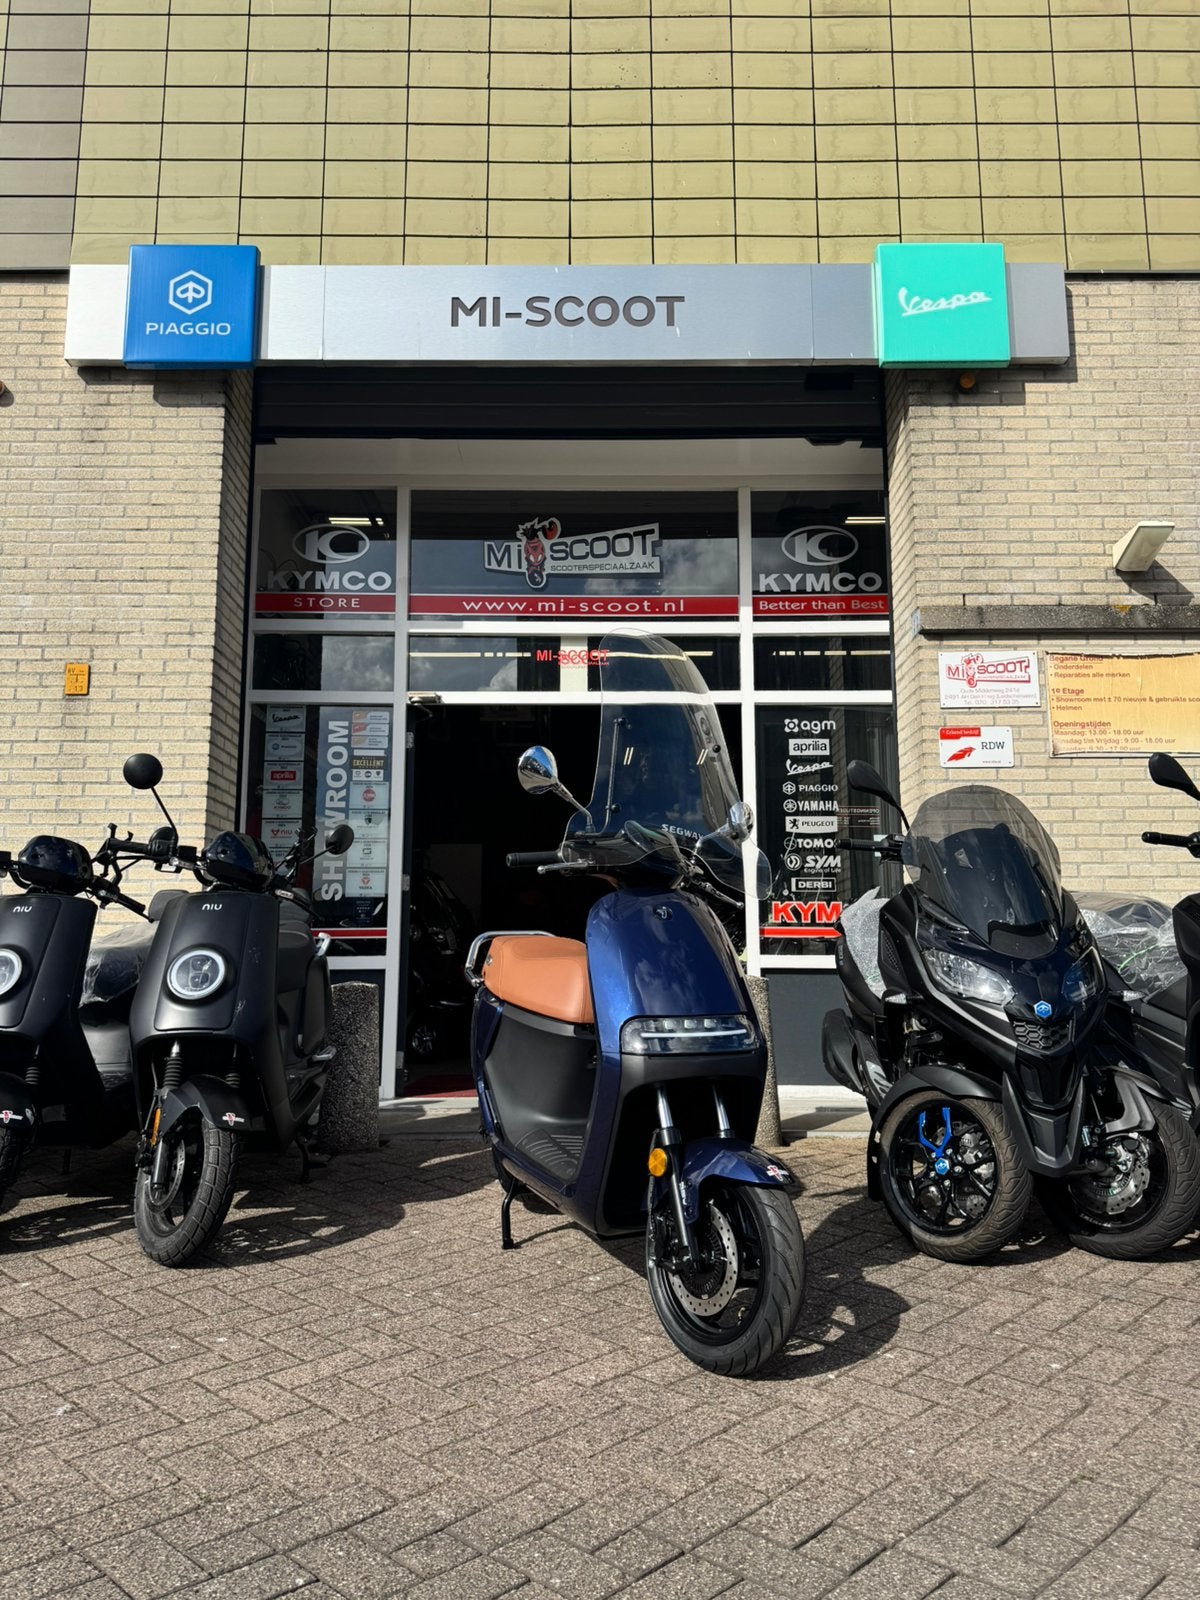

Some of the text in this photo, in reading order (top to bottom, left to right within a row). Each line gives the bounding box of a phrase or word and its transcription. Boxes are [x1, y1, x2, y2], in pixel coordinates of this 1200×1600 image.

[898, 286, 992, 318] Vespa
[450, 296, 685, 328] MI-SCOOT
[145, 321, 232, 336] PIAGGIO
[549, 528, 656, 562] SCOOT
[550, 561, 656, 572] SCOOTERSPECIAALZAAK
[267, 570, 393, 592] KYMCO
[759, 571, 882, 593] KYMCO
[293, 596, 361, 609] STORE
[462, 599, 686, 615] www.mi-scoot.nl
[759, 599, 885, 611] Better than Best
[977, 660, 1026, 675] SCOOT
[1062, 687, 1085, 696] Etage
[800, 719, 837, 734] agm
[1053, 720, 1112, 729] Openingstijden
[792, 740, 828, 754] aprilia
[981, 741, 1005, 751] RDW
[352, 759, 385, 767] EXCELLENT
[786, 758, 834, 776] Vespa
[798, 784, 839, 793] PIAGGIO
[320, 720, 350, 902] SHWROOM
[797, 800, 840, 812] YAMAHA
[801, 820, 835, 828] PEUGEOT
[803, 855, 842, 868] SYM
[797, 880, 833, 889] DERBI
[772, 901, 843, 924] KYM
